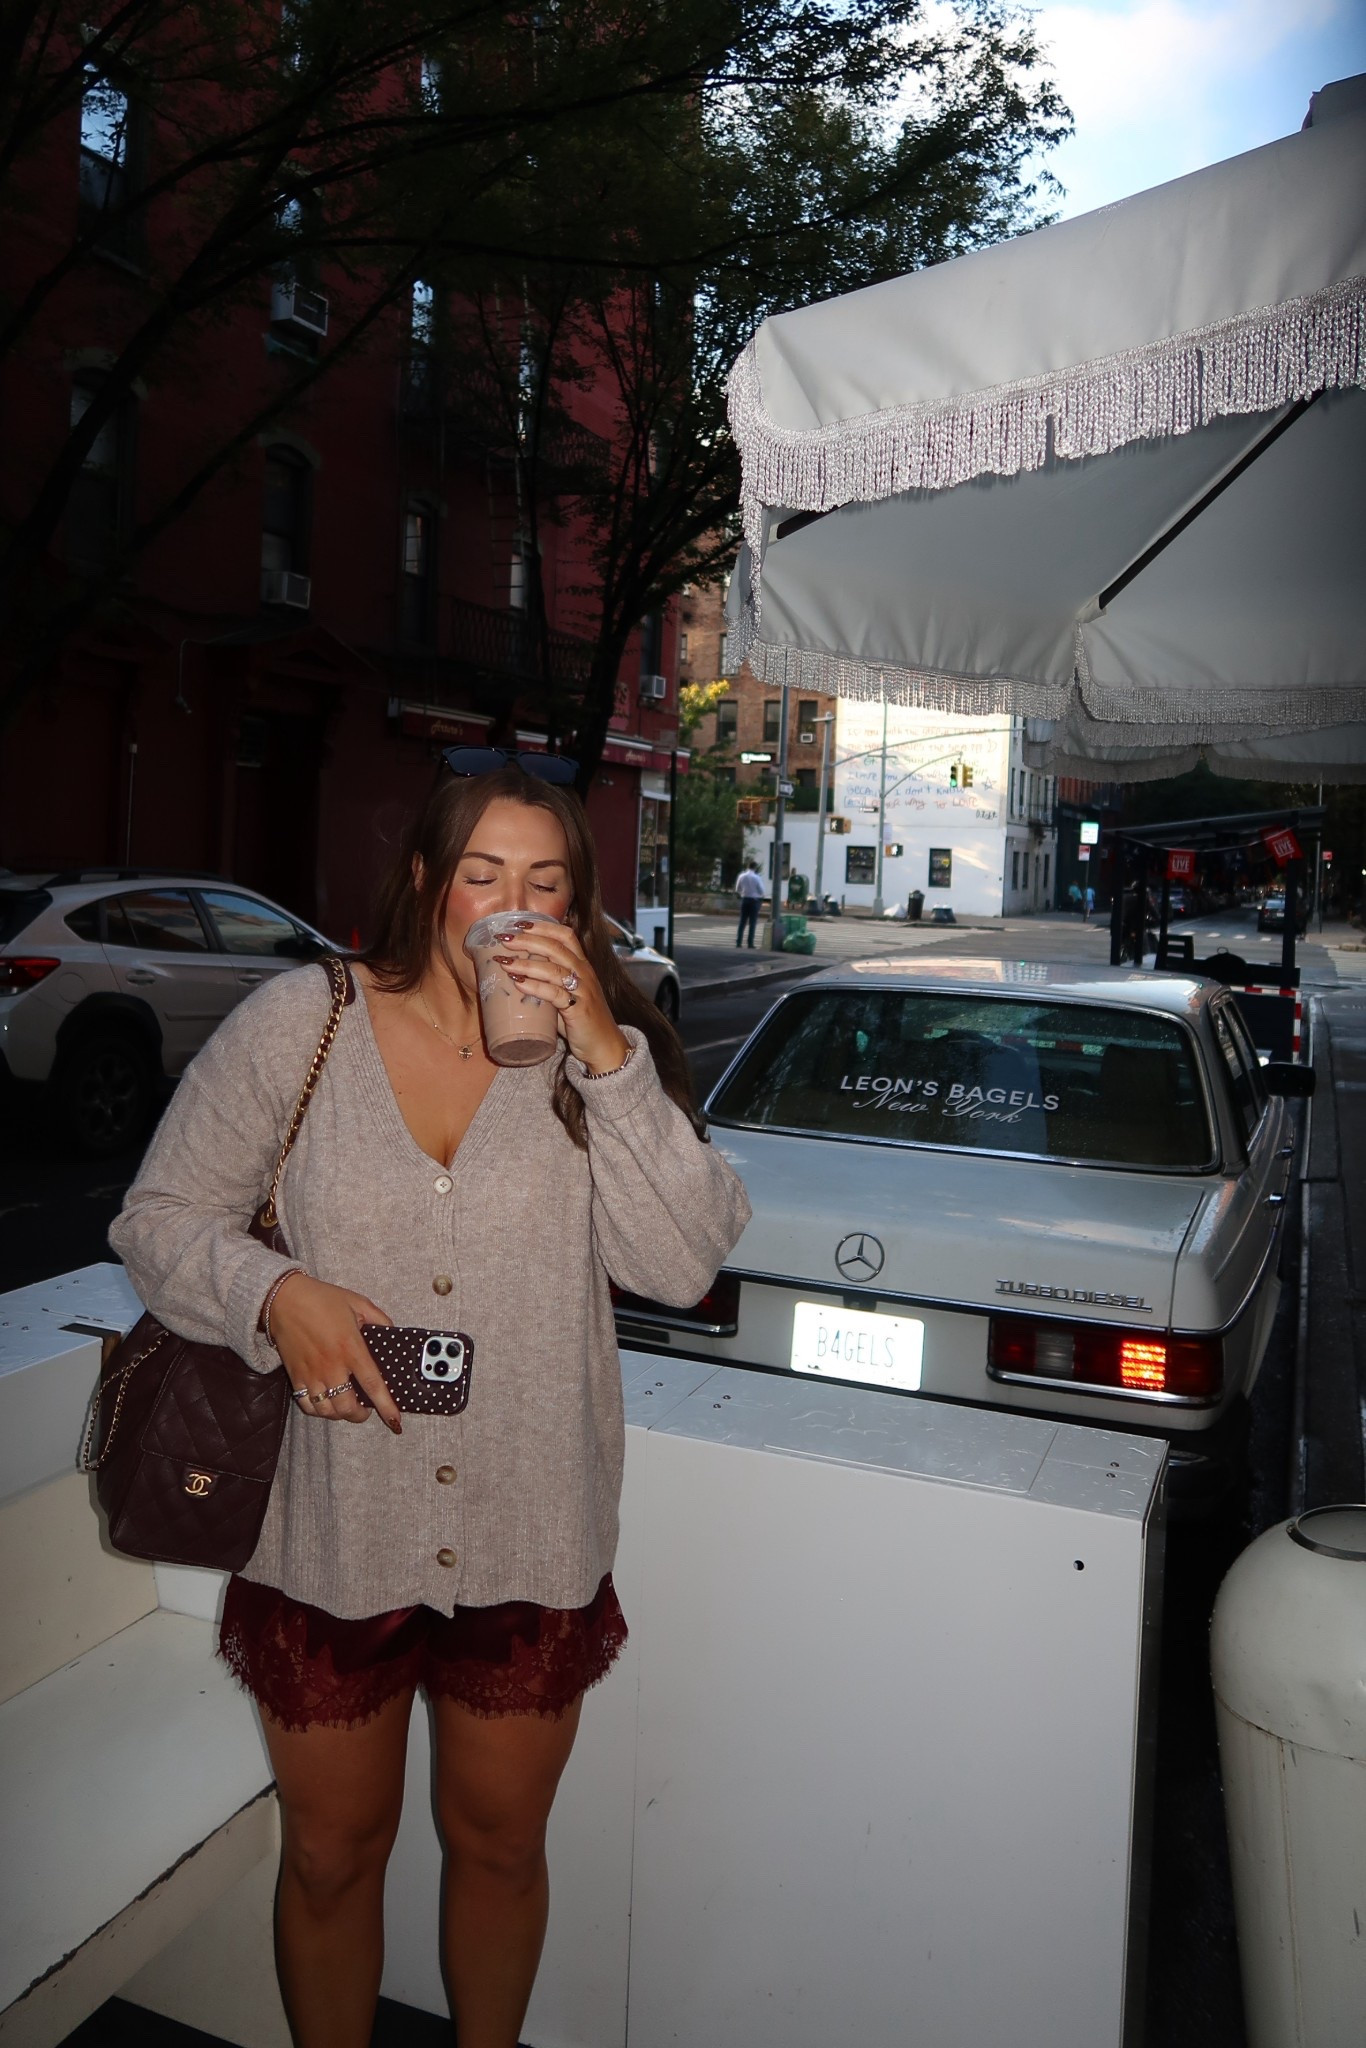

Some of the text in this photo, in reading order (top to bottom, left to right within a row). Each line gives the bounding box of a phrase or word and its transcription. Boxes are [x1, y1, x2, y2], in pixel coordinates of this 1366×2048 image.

[840, 1075, 1060, 1111] LEON'S BAGELS
[852, 1088, 1030, 1124] New York
[817, 1326, 895, 1368] B4GELS
